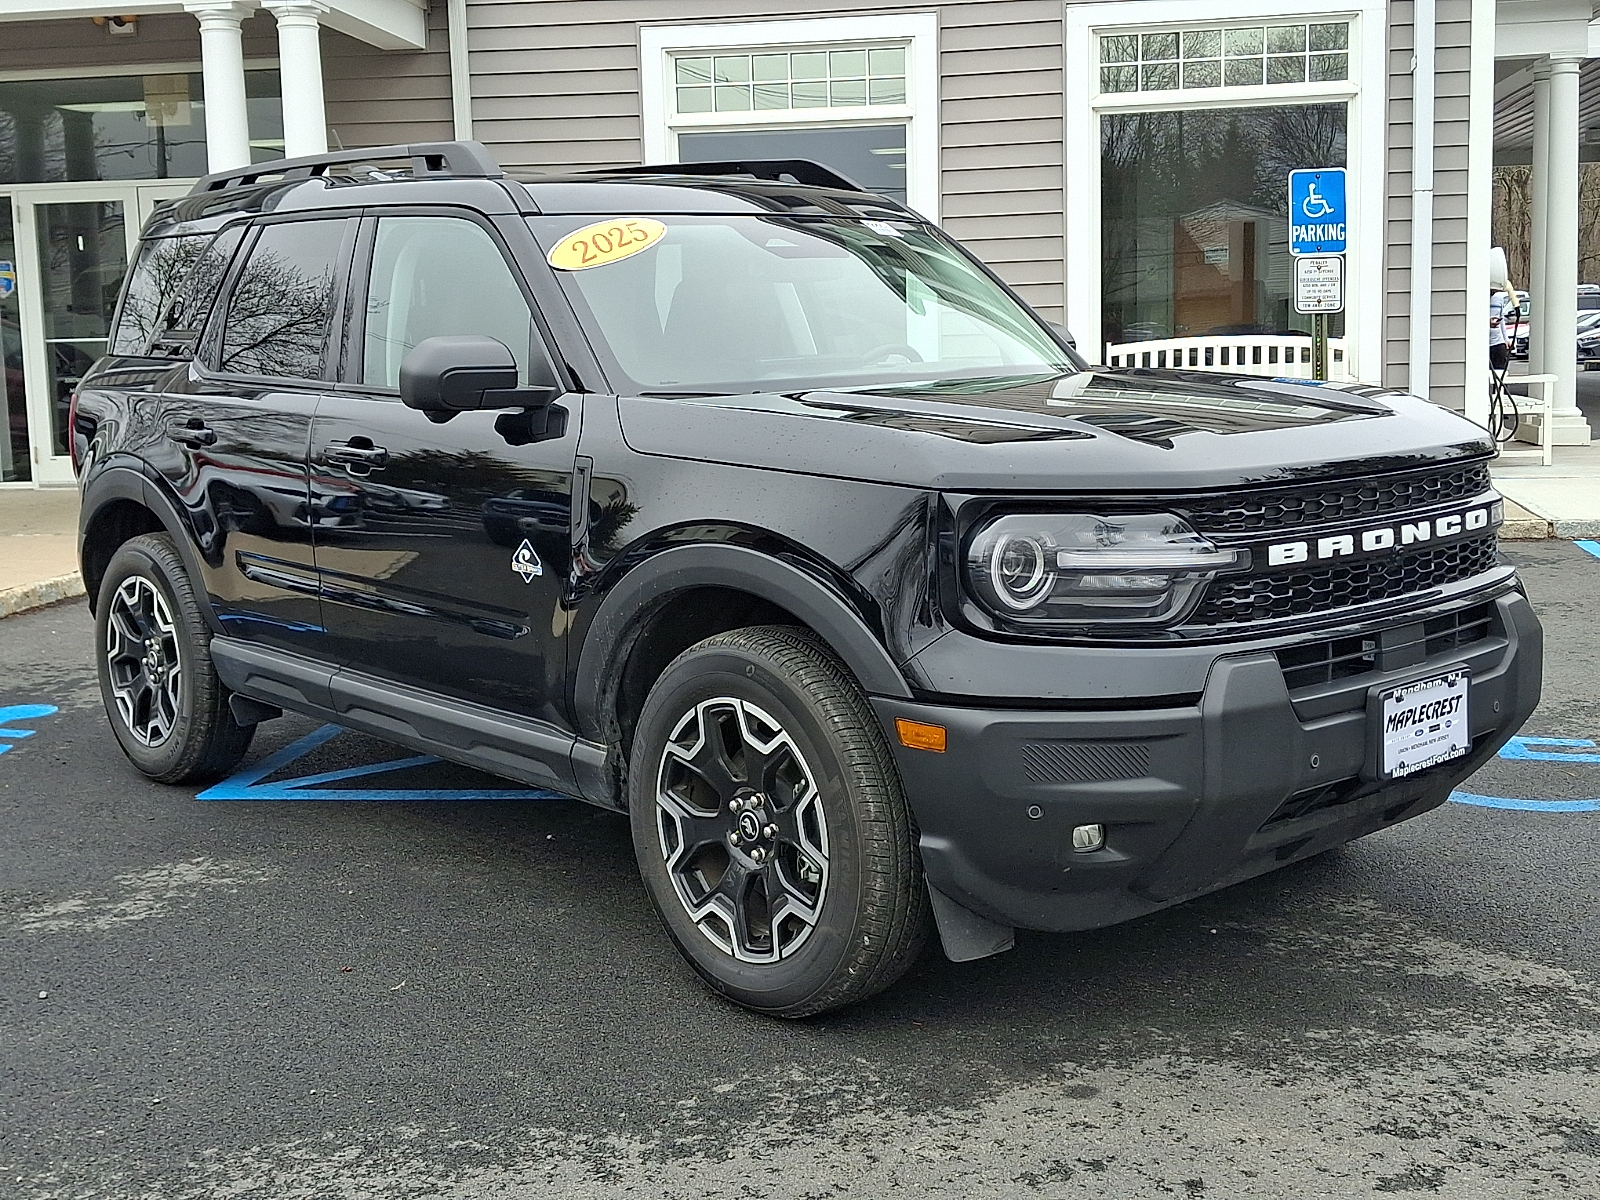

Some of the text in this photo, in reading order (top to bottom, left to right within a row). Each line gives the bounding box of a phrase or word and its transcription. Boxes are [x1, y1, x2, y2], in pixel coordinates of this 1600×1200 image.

[572, 222, 649, 264] 2025
[1292, 223, 1345, 242] PARKING
[1268, 508, 1488, 566] BRONCO
[1448, 672, 1462, 683] NJ
[1386, 694, 1464, 733] MAPLECREST
[1392, 747, 1466, 778] MaplecrestFord.com
